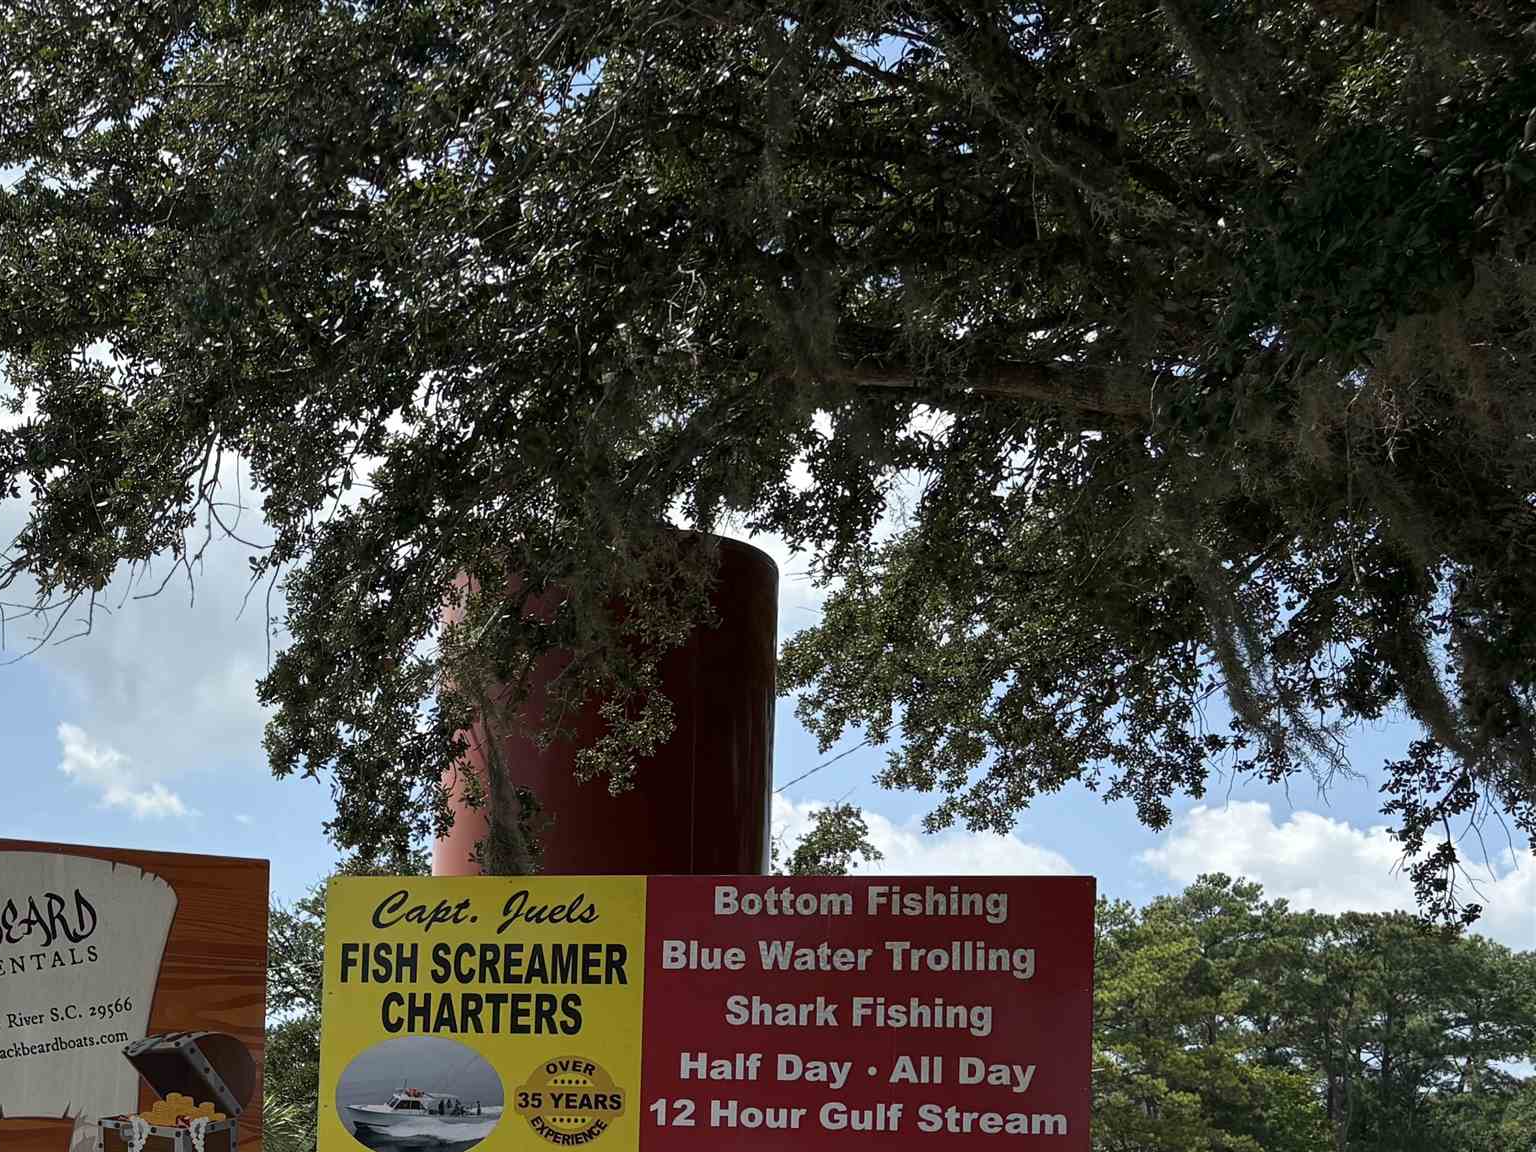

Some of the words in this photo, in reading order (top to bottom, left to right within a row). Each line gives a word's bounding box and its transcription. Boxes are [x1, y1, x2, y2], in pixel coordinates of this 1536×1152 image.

[372, 890, 478, 932] Capt.
[497, 890, 599, 934] Juels
[714, 885, 853, 916] Bottom
[867, 886, 1008, 924] Fishing
[340, 942, 418, 983] FISH
[431, 942, 628, 984] SCREAMER
[662, 940, 746, 970] Blue
[759, 940, 873, 972] Water
[885, 941, 1036, 979] Trolling
[6, 1012, 45, 1028] River
[50, 1005, 82, 1022] S.C.
[89, 997, 132, 1019] 29566
[381, 992, 582, 1035] CHARTERS
[725, 996, 838, 1026] Shark
[852, 997, 993, 1036] Fishing
[546, 1060, 596, 1076] OVER
[679, 1052, 762, 1081] Half
[776, 1054, 852, 1090] Day
[889, 1055, 943, 1084] All
[959, 1057, 1036, 1093] Day
[518, 1092, 542, 1109] 35
[550, 1093, 622, 1110] YEARS
[649, 1098, 696, 1127] 12
[710, 1100, 807, 1129] Hour
[819, 1102, 903, 1131] Gulf
[917, 1105, 1067, 1135] Stream
[530, 1116, 608, 1146] EXPERIENCE
